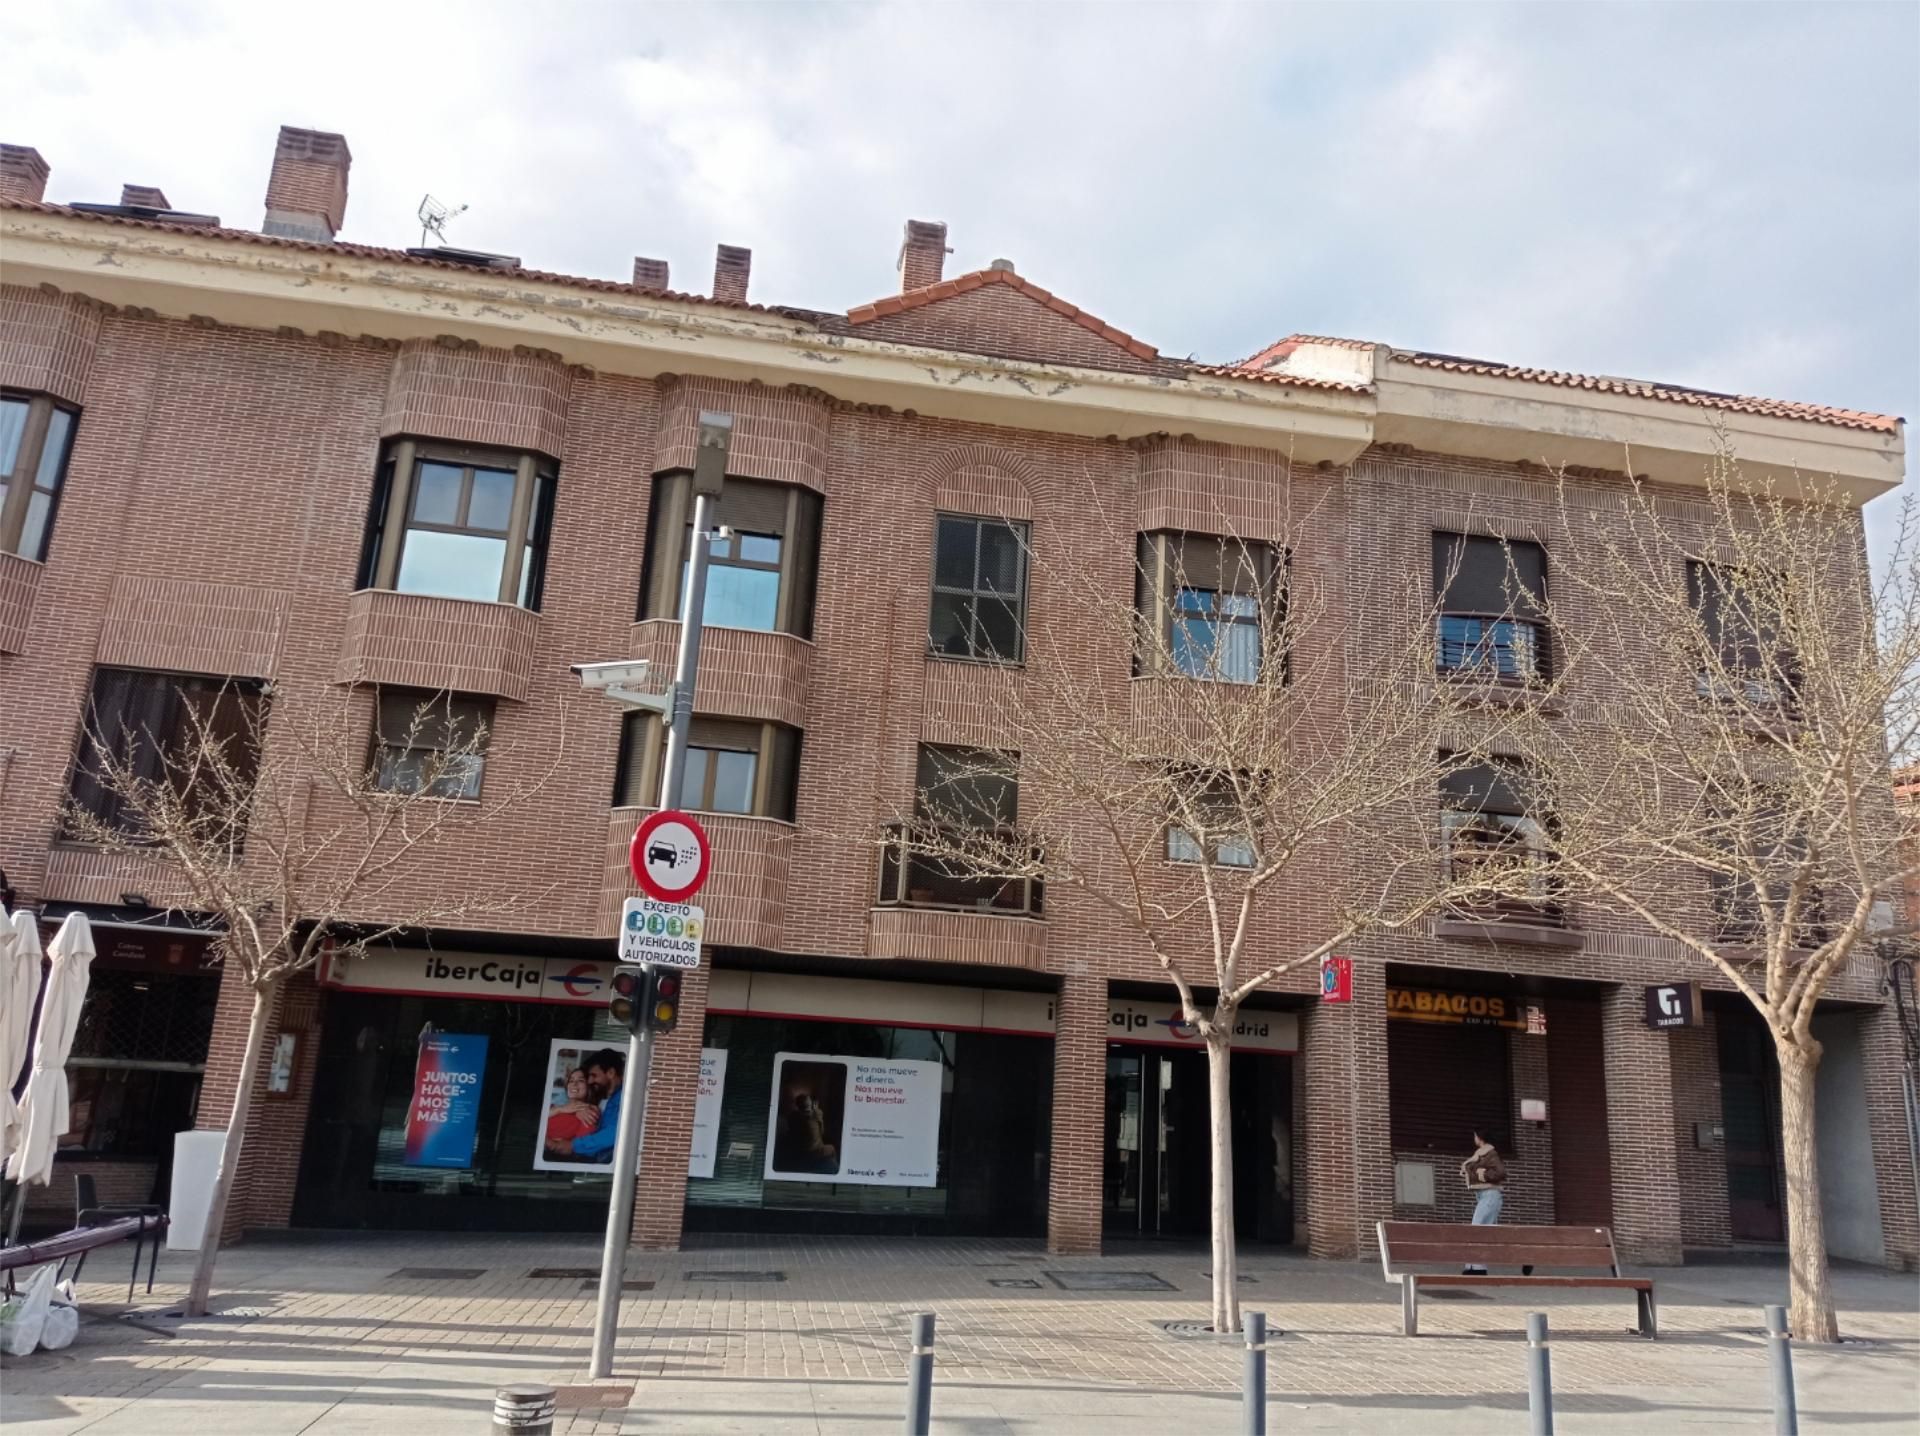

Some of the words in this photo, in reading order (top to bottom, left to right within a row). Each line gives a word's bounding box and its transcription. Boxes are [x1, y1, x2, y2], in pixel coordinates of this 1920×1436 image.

[643, 901, 691, 916] EXCEPTO
[629, 934, 636, 945] Y
[640, 935, 696, 952] VEHÍCULOS
[624, 949, 697, 966] AUTORIZADOS
[425, 957, 540, 989] iberCaja
[1386, 989, 1505, 1017] TABACOS
[856, 1065, 869, 1073] No
[889, 1067, 918, 1076] mueve
[423, 1071, 477, 1084] JUNTOS
[855, 1075, 864, 1083] el
[421, 1084, 466, 1096] HACE-
[874, 1087, 903, 1095] mueve
[419, 1096, 451, 1109] MOS
[854, 1095, 864, 1103] tu
[416, 1108, 449, 1123] MÁS
